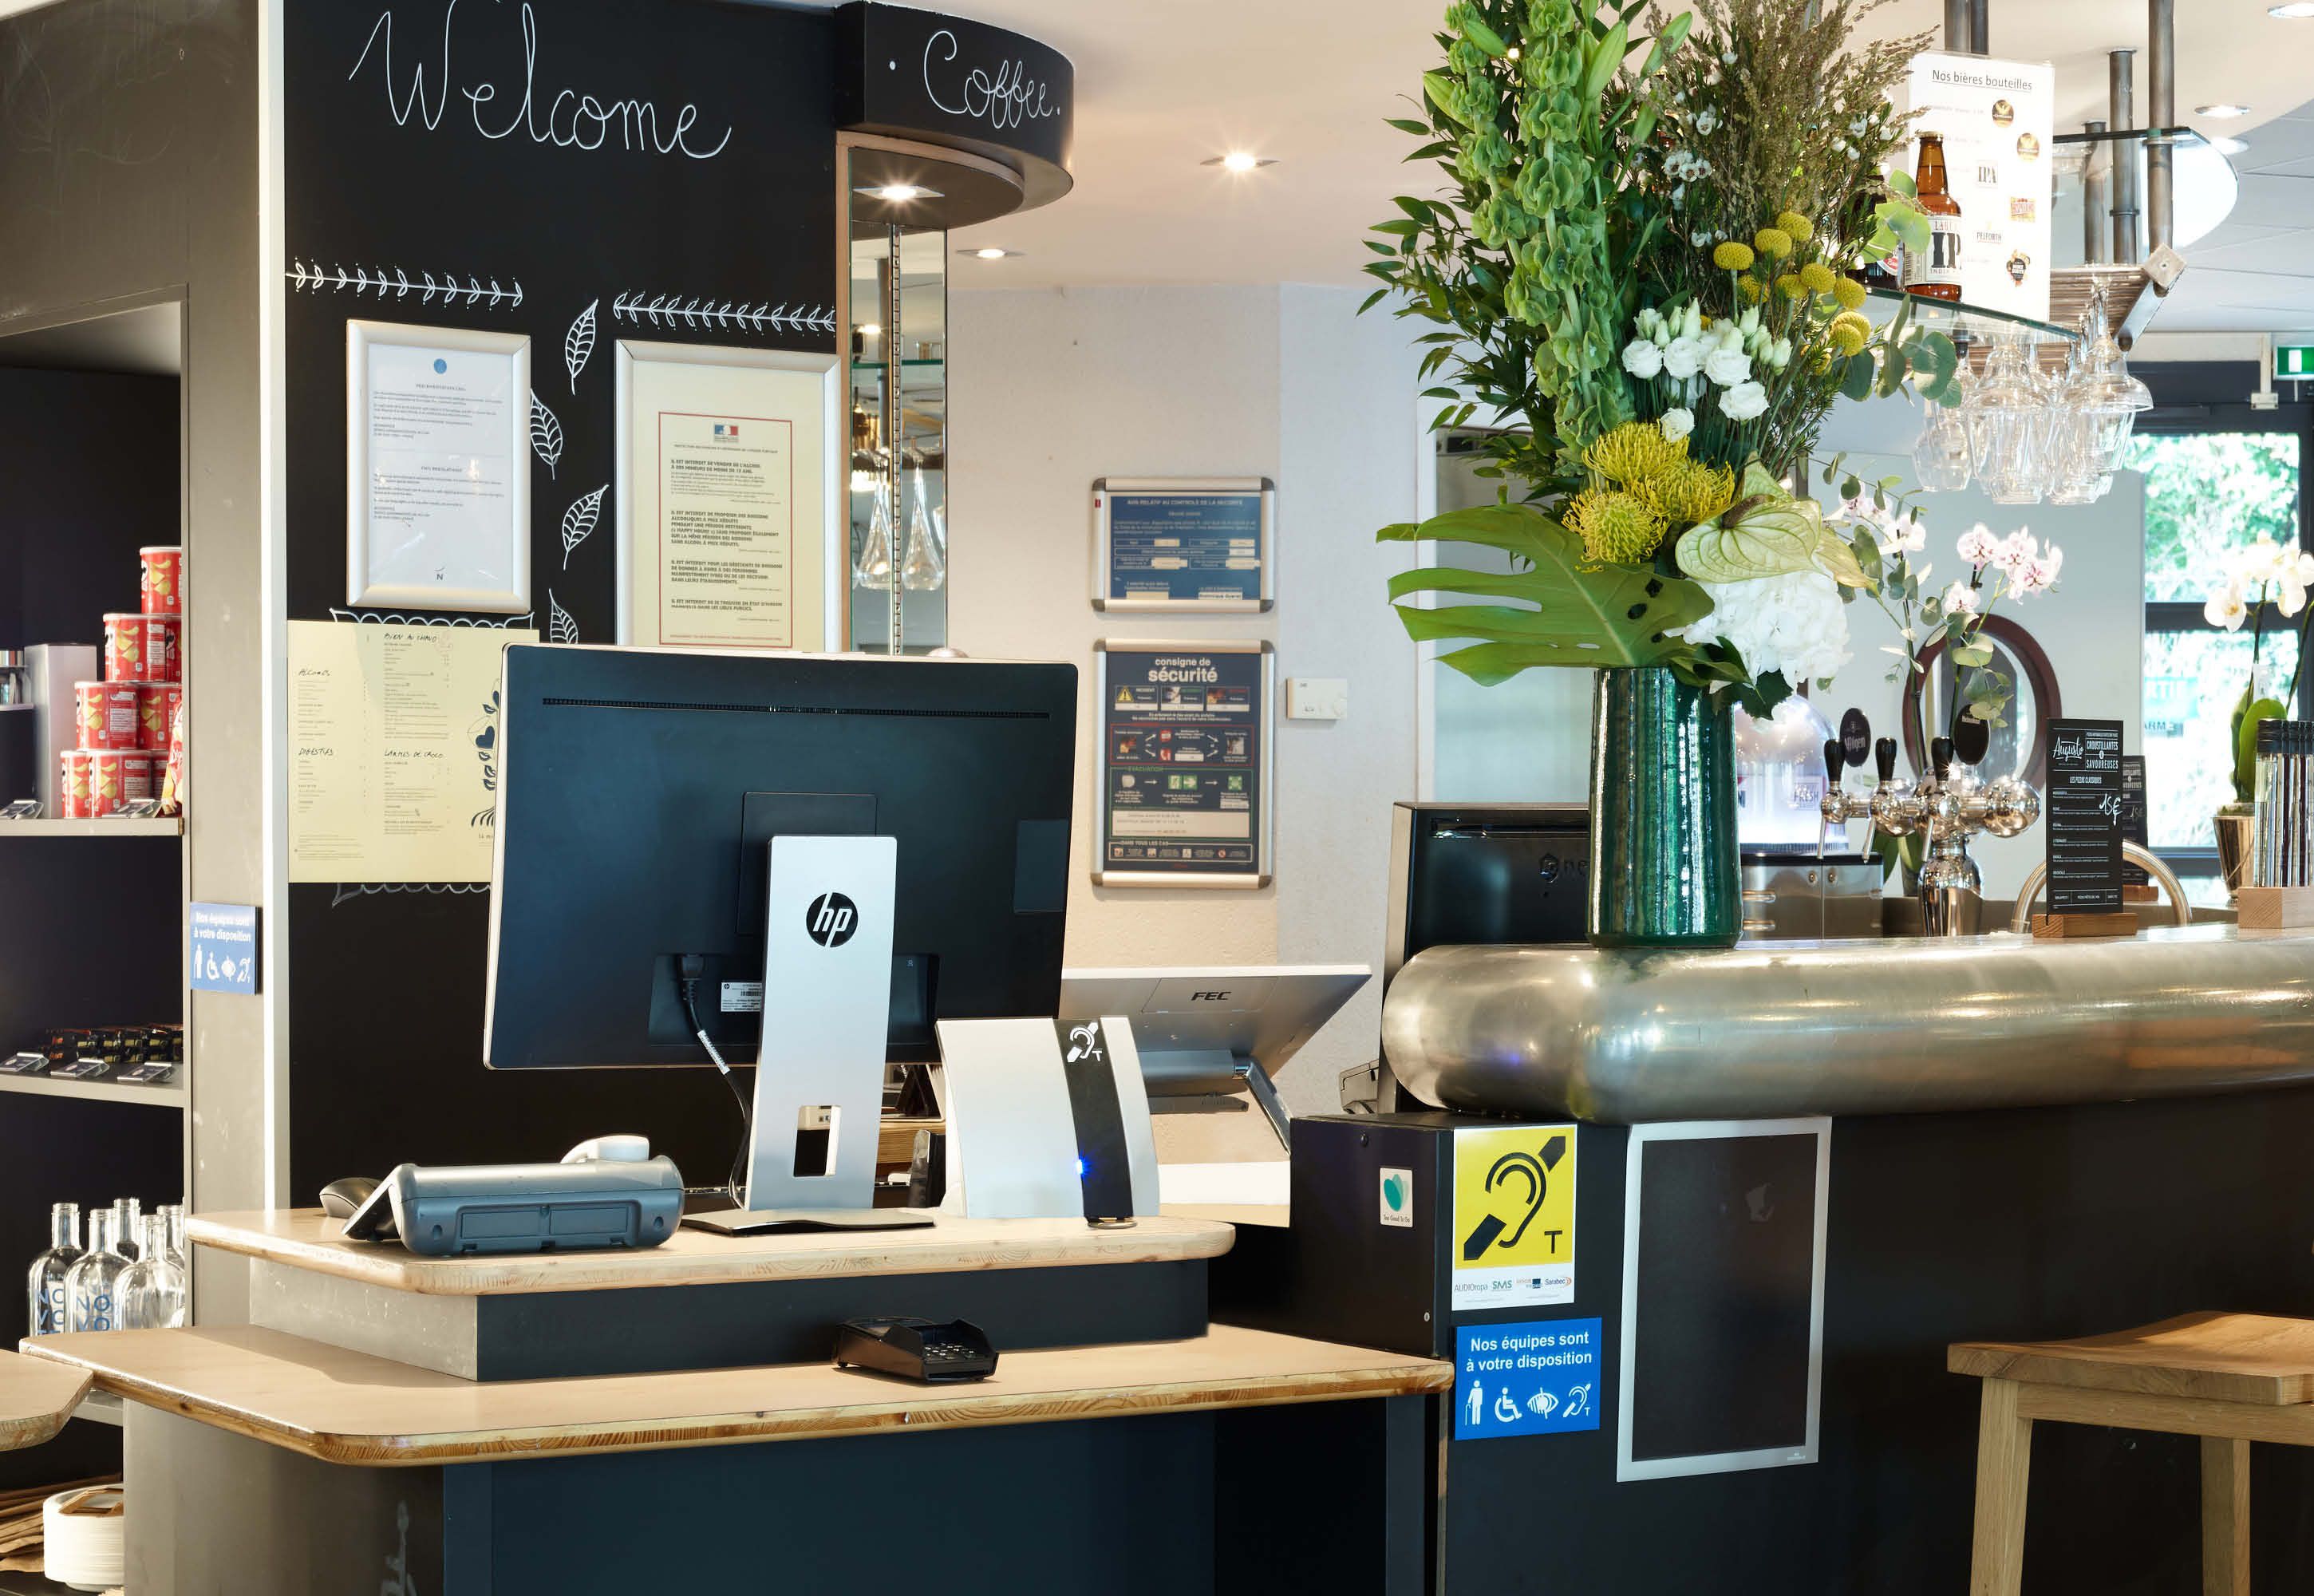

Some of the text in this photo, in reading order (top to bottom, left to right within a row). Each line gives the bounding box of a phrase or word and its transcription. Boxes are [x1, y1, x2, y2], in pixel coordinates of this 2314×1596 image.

[349, 0, 732, 159] Welcome
[1933, 69, 2033, 91] Nos bières bouteilles
[1978, 165, 1997, 184] IPA
[1155, 657, 1211, 667] consigne de
[1147, 667, 1218, 683] sécurité
[2053, 736, 2084, 762] Augusto
[2087, 740, 2119, 751] CROUSTILLANTES
[2086, 759, 2119, 769] SAVOUREUSES
[812, 892, 854, 947] hp
[1191, 991, 1232, 1001] FEC
[1544, 1230, 1563, 1254] T
[1492, 1279, 1513, 1290] SMS
[1544, 1277, 1566, 1286] Sarabec
[1471, 1330, 1589, 1353] Nos équipes sont
[1466, 1351, 1593, 1372] à votre disposition
